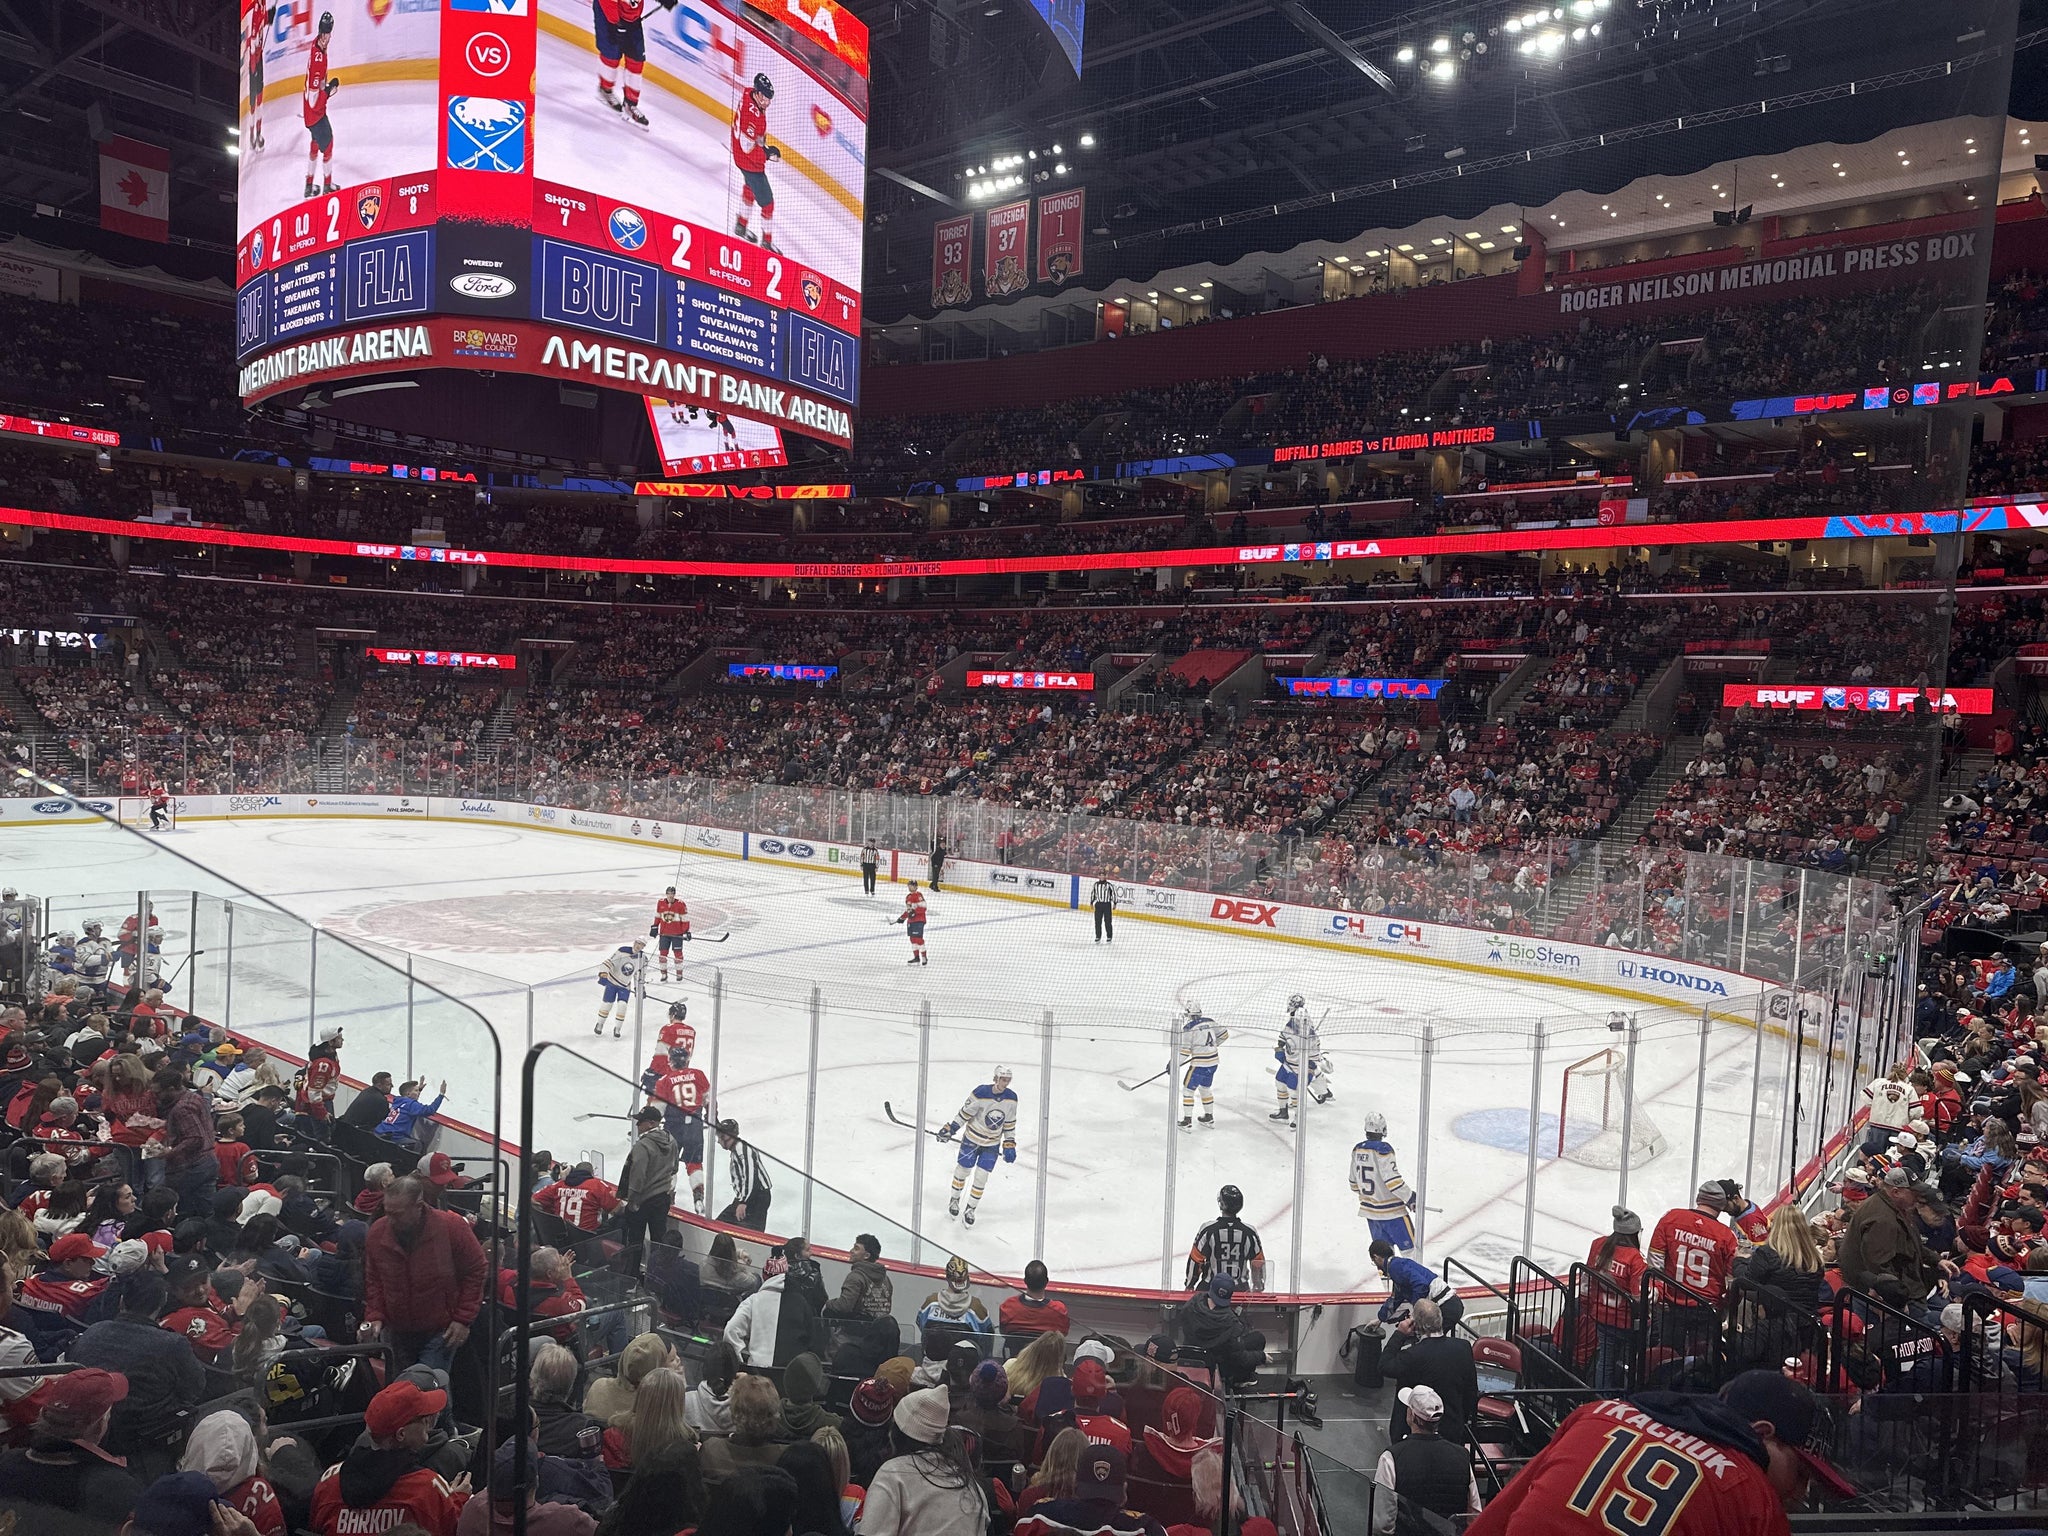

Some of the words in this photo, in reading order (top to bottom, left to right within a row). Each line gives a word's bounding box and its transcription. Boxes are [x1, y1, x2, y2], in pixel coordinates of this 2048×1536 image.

[475, 46, 501, 64] VS
[398, 184, 429, 197] SHOTS
[410, 196, 417, 214] 8
[544, 193, 586, 212] SHOTS
[1043, 195, 1080, 216] LUONGO
[326, 196, 340, 242] 2
[560, 208, 570, 226] 7
[990, 207, 1025, 227] HUIZENGA
[1056, 215, 1065, 237] 1
[272, 219, 281, 262] 2
[296, 213, 309, 236] 0.0
[939, 223, 968, 242] TORREY
[999, 227, 1017, 251] 37
[296, 237, 315, 250] PERIOD
[671, 224, 692, 270] 2
[719, 245, 742, 272] 0.0
[944, 242, 962, 265] 93
[294, 262, 308, 274] HITS
[463, 259, 492, 267] POWERED
[493, 260, 503, 268] BY
[294, 271, 325, 287] ATTEMPTS
[358, 245, 413, 308] FLA
[721, 270, 751, 288] PERIOD
[766, 257, 781, 300] 2
[1560, 286, 1623, 314] ROGER
[1628, 272, 1714, 304] NEILSON
[1720, 250, 1837, 292] MEMORIAL
[1843, 241, 1920, 274] PRESS
[1927, 233, 1977, 261] BOX
[463, 277, 502, 294] Ford
[562, 256, 642, 327] BUF
[676, 279, 685, 291] 10
[718, 293, 742, 308] HITS
[284, 287, 320, 304] GIVEAWAYS
[835, 292, 856, 308] SHOTS
[283, 300, 320, 318] TAKEAWAYS
[676, 294, 685, 305] 14
[692, 299, 716, 314] SHOT
[718, 306, 765, 328] ATTEMPTS
[280, 318, 304, 332] BLOCKED
[304, 313, 324, 326] SHOTS
[678, 307, 683, 319] 3
[700, 315, 757, 339] GIVEAWAYS
[698, 327, 758, 352] TAKEAWAYS
[457, 349, 515, 358] FLORIDA
[677, 334, 682, 346] 3
[691, 338, 733, 360] BLOCKED
[734, 352, 764, 368] SHOTS
[801, 326, 845, 390] FLA
[239, 348, 296, 396] AMERANT
[298, 336, 346, 374] BANK
[350, 326, 428, 364] ARENA
[542, 335, 716, 398] AMERANT
[719, 375, 785, 416] BANK
[786, 395, 851, 438] ARENA
[1794, 393, 1856, 412] BUF
[1947, 378, 2016, 400] FLA
[1274, 445, 1318, 462] BUFFALO
[1321, 439, 1363, 458] SABRES
[1366, 441, 1380, 452] VS
[1382, 432, 1428, 453] FLORIDA
[1432, 426, 1495, 448] PANTHERS
[350, 462, 388, 475] BUF
[440, 470, 477, 483] FLA
[984, 475, 1013, 489] BUF
[1053, 469, 1084, 482] FLA
[726, 485, 774, 498] VS
[357, 544, 396, 557] BUF
[449, 551, 487, 562] FLA
[1239, 548, 1279, 560] BUF
[1336, 542, 1382, 555] FLA
[794, 564, 828, 576] BUFFALO
[830, 564, 862, 576] SABRES
[874, 564, 902, 575] FLORIDA
[904, 563, 941, 574] PANTHERS
[466, 656, 499, 665] FLA
[1464, 659, 1478, 668] 119
[1687, 661, 1705, 670] 120
[982, 674, 1010, 685] BUF
[1048, 676, 1078, 686] FLA
[1387, 683, 1430, 694] FLA
[1757, 690, 1815, 704] BUF
[460, 800, 496, 813] Sandals
[1154, 892, 1176, 904] JOINT
[1210, 898, 1281, 928] DEX
[1323, 928, 1344, 936] Cooper
[1332, 915, 1364, 933] CH
[1388, 923, 1421, 941] CH
[1378, 936, 1399, 944] Cooper
[1409, 941, 1431, 949] Hunter
[1509, 942, 1580, 966] BioStem
[1640, 965, 1728, 996] HONDA
[318, 1062, 328, 1072] 13
[670, 1073, 696, 1084] TKACHUK
[672, 1083, 697, 1107] 19
[1881, 1084, 1906, 1096] FLORIDA
[557, 1188, 589, 1198] TKACHUK
[560, 1196, 583, 1226] 19
[1675, 1228, 1716, 1252] TKACHUK
[1221, 1243, 1240, 1260] 34
[1676, 1244, 1710, 1288] 19
[1593, 1399, 1737, 1480] TKACHUK
[1566, 1424, 1703, 1536] 19
[336, 1508, 405, 1534] BARKOV
